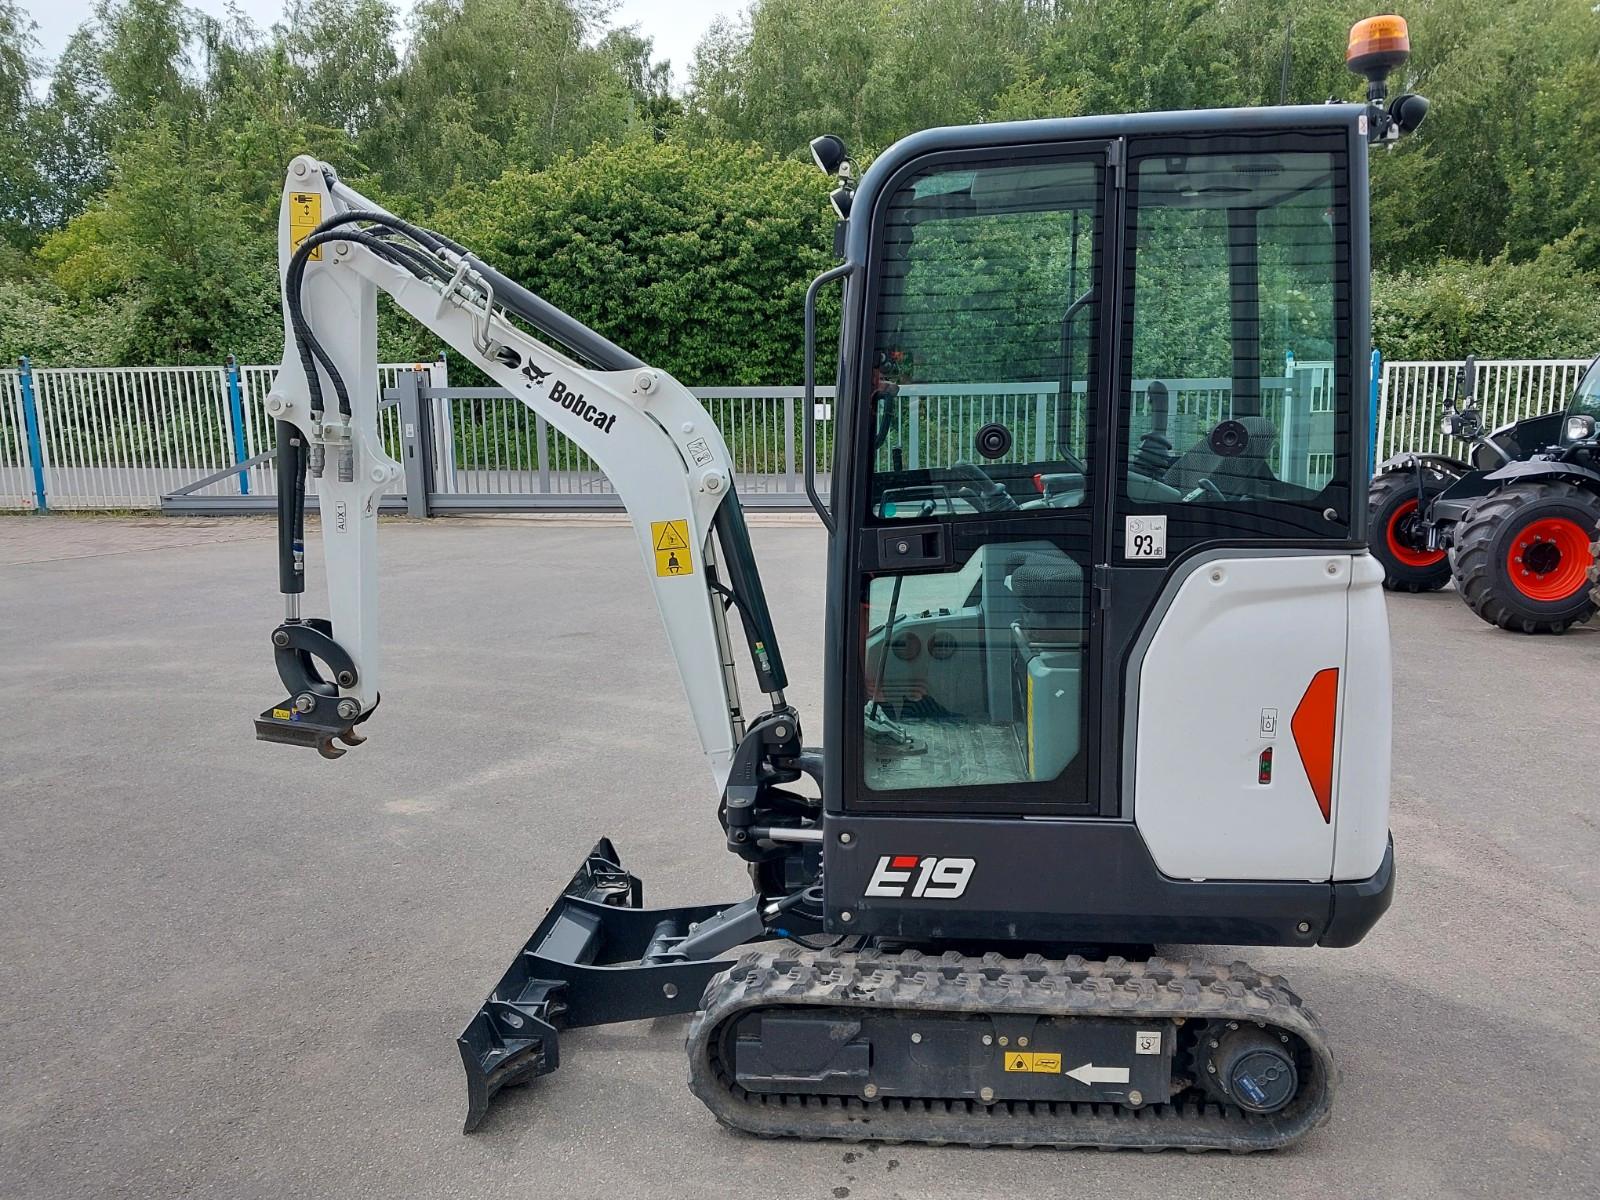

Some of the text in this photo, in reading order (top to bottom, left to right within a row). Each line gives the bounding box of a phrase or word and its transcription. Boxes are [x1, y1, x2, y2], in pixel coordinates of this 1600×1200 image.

[548, 380, 616, 434] Bobcat
[337, 512, 345, 530] AUX
[1134, 535, 1153, 556] 93
[864, 856, 976, 898] E19
